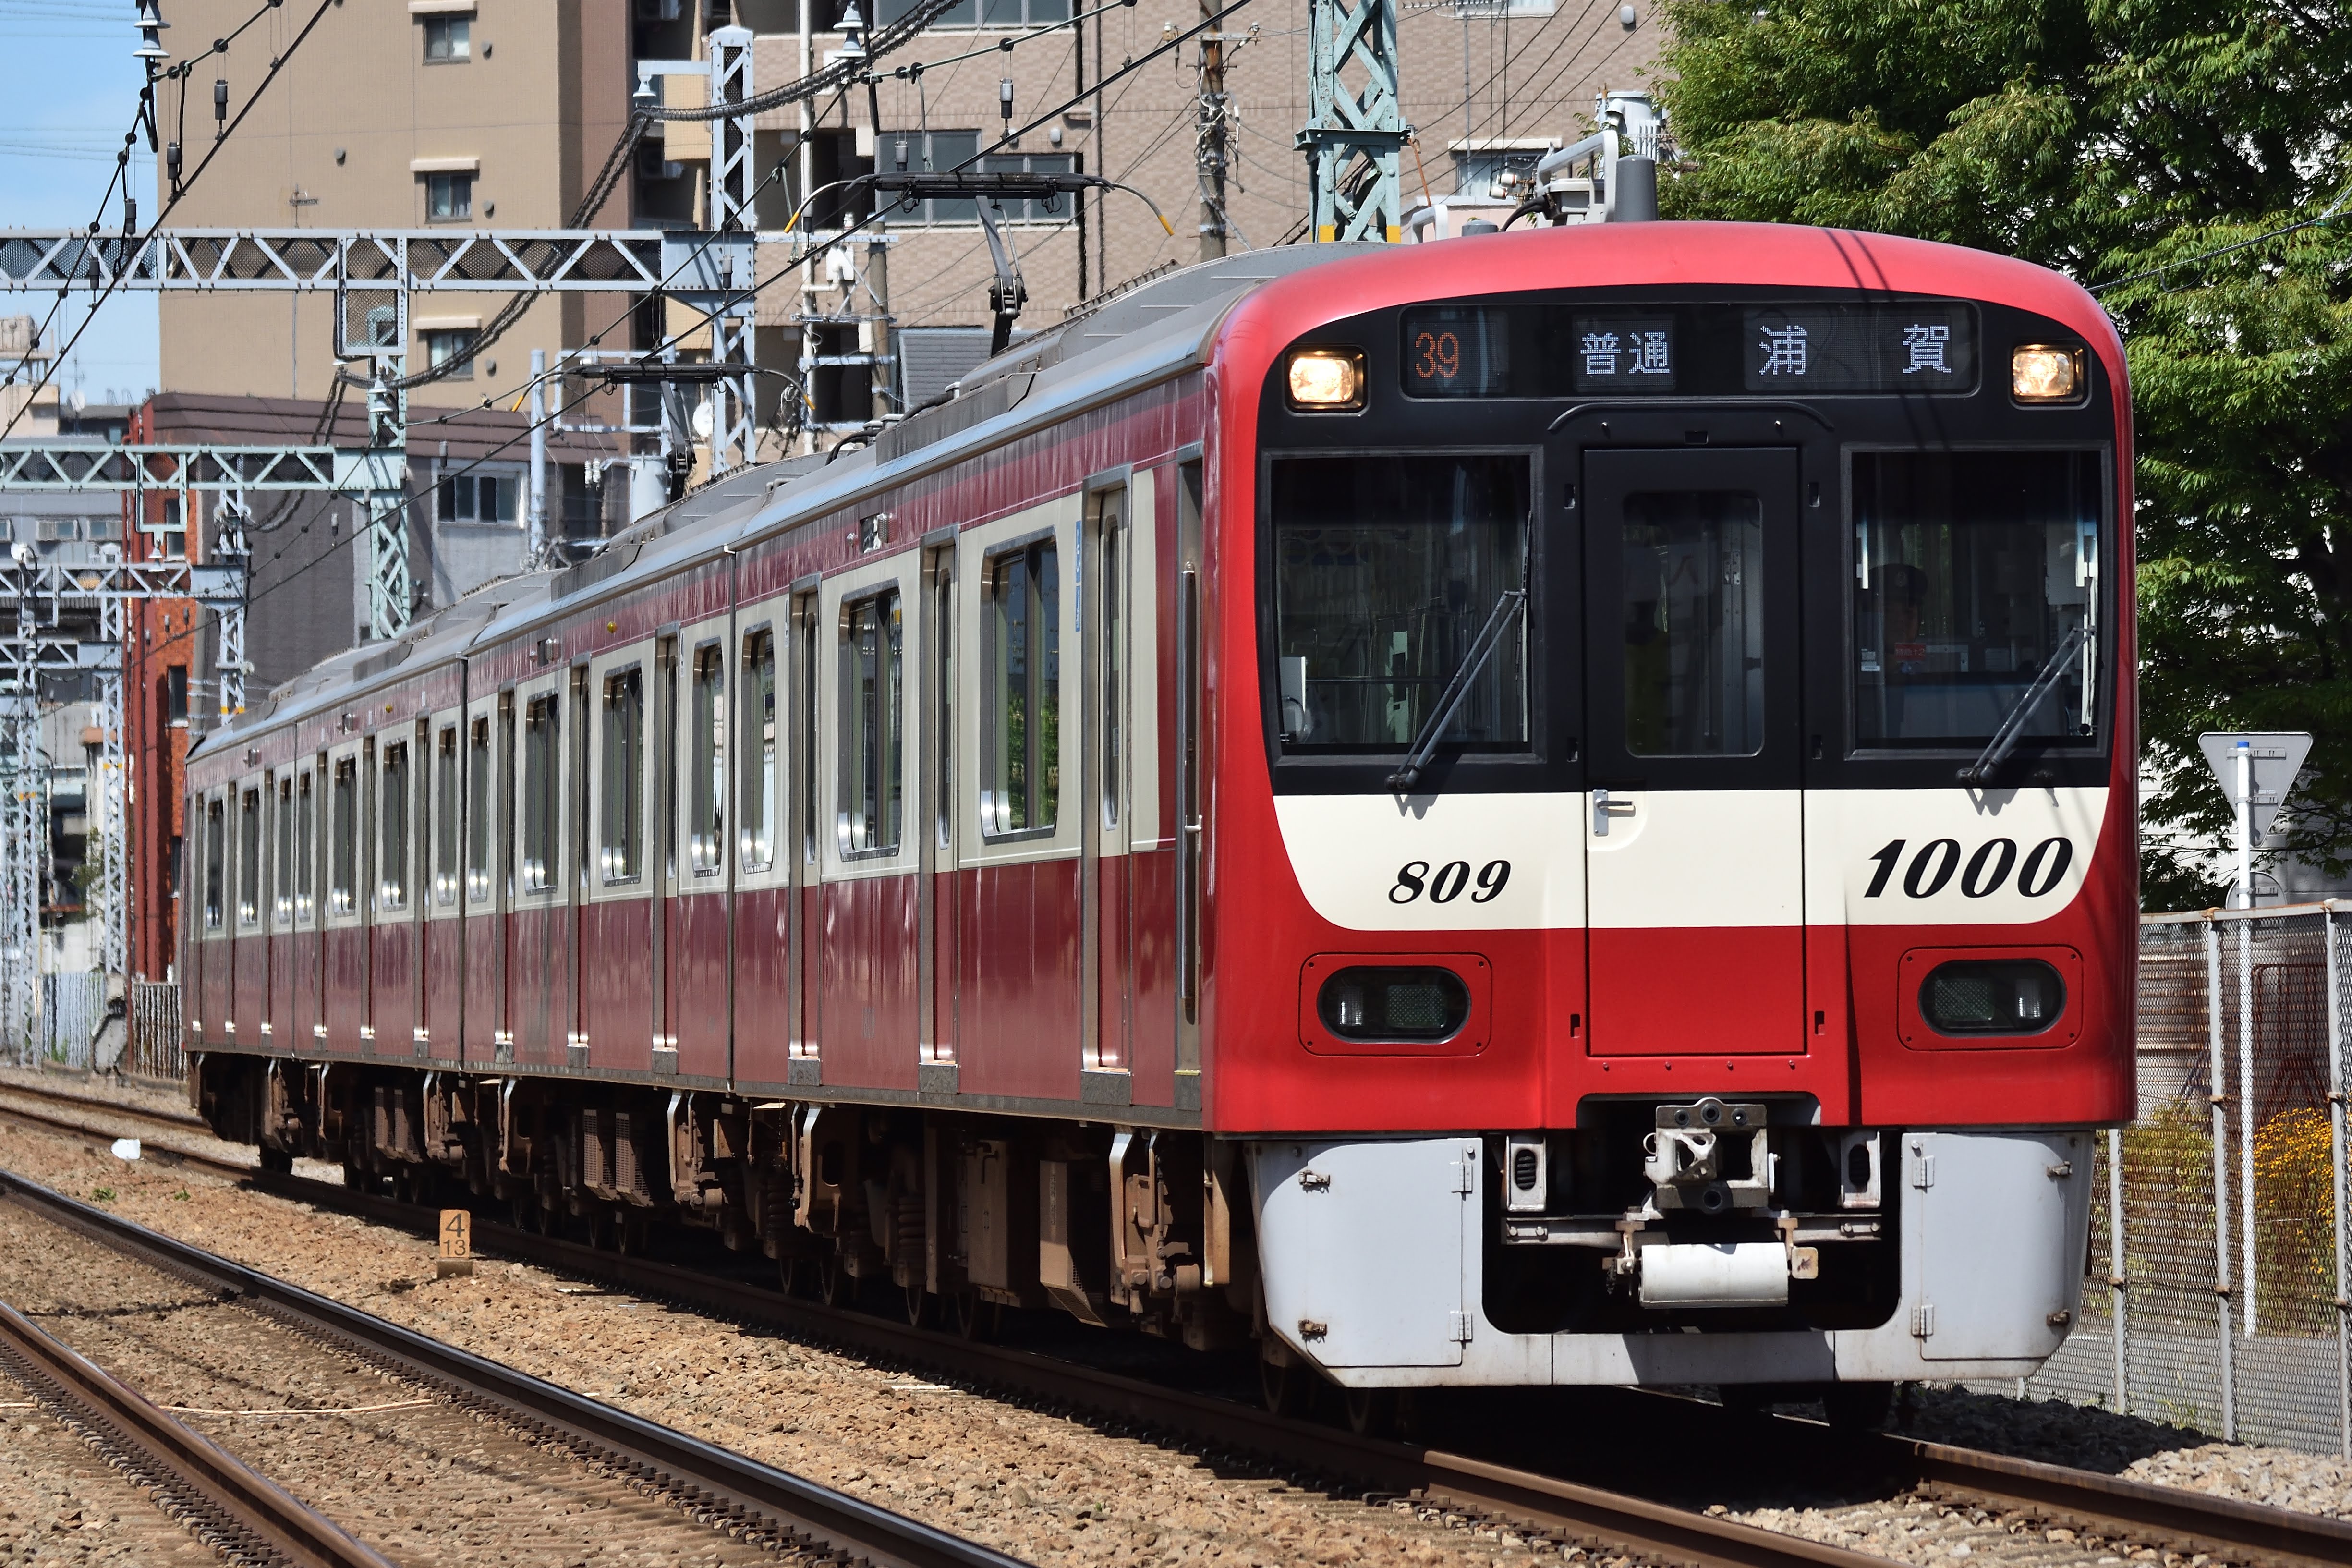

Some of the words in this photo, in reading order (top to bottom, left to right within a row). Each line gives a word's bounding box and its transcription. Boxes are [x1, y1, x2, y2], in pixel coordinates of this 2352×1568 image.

[1415, 332, 1459, 378] 39
[1580, 331, 1670, 375] 普通
[1388, 860, 1511, 904] 809
[1864, 837, 2073, 899] 1000
[443, 1239, 466, 1256] 13
[445, 1213, 465, 1238] 4
